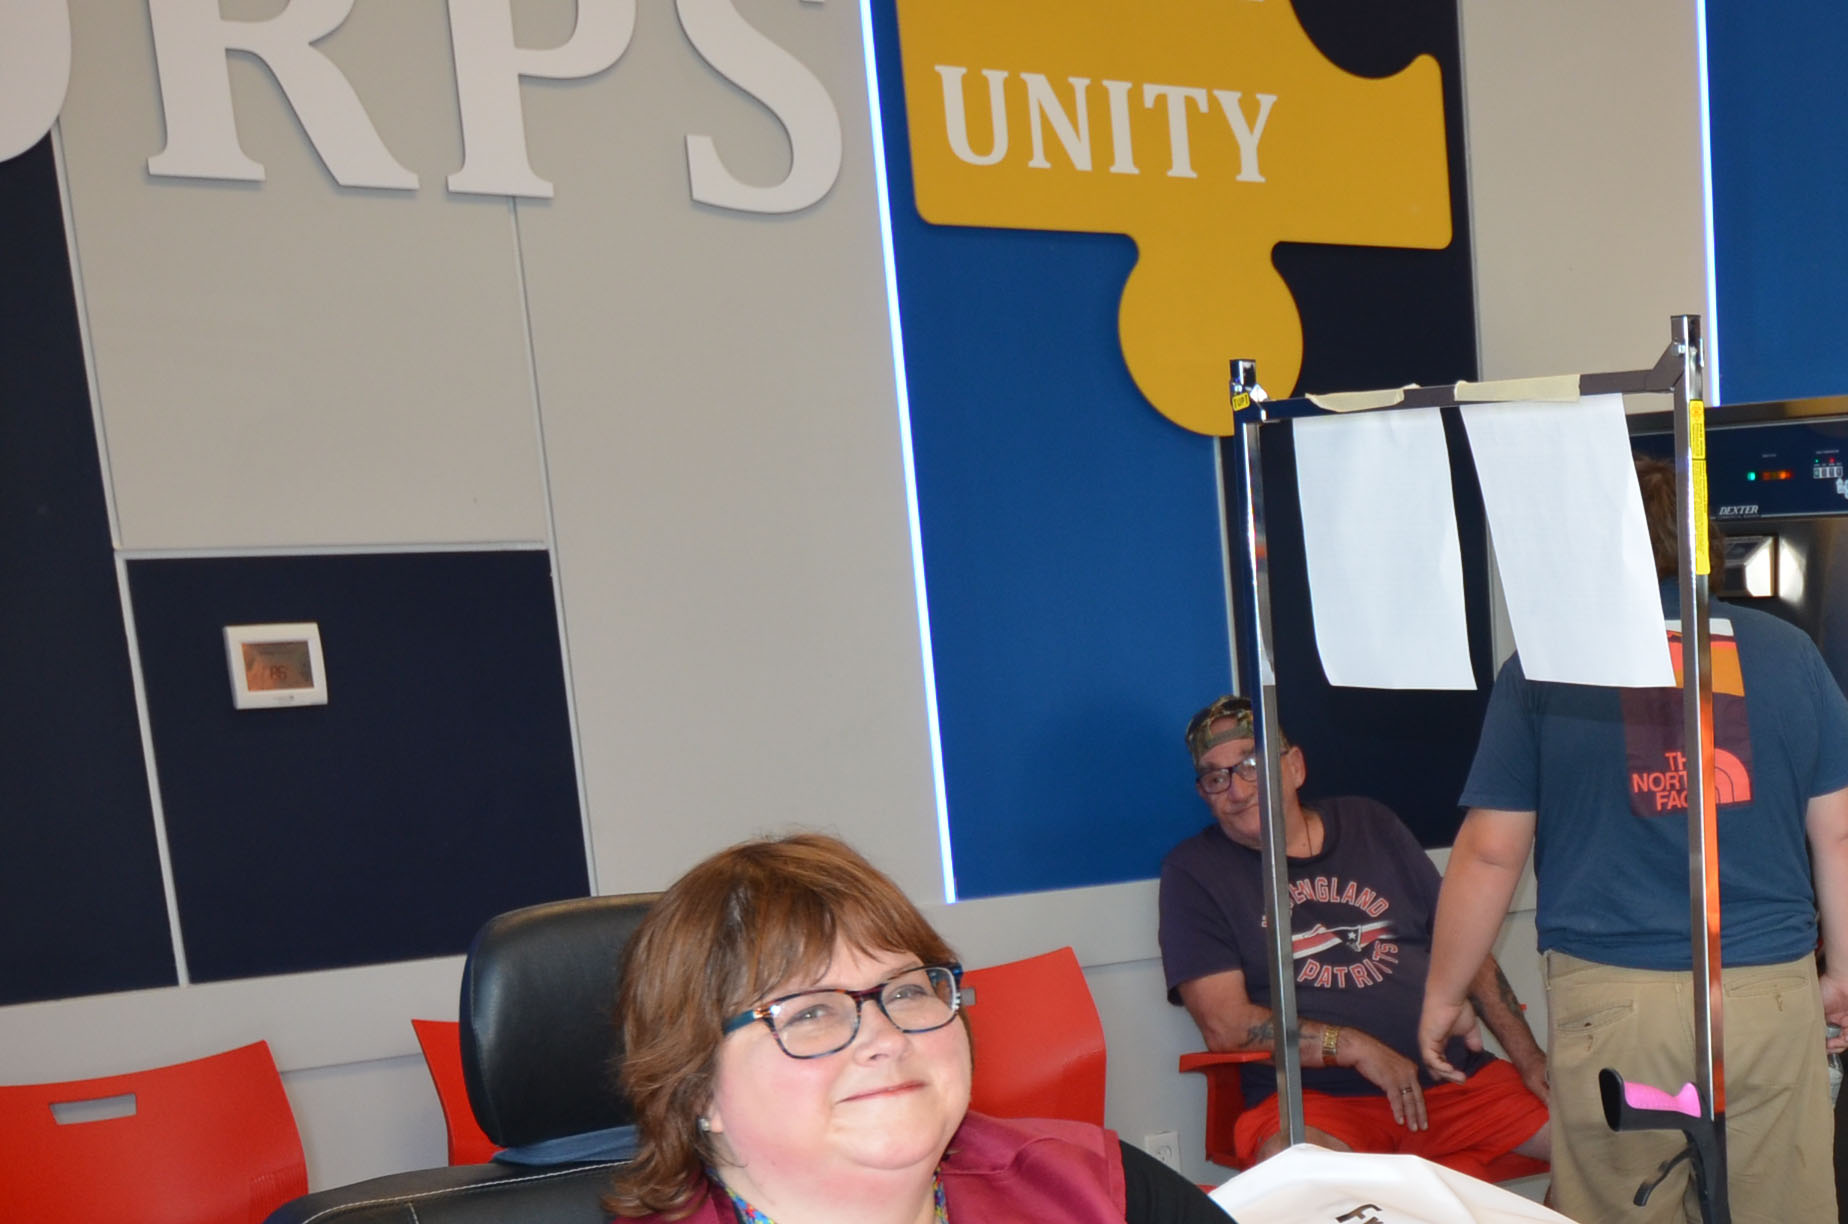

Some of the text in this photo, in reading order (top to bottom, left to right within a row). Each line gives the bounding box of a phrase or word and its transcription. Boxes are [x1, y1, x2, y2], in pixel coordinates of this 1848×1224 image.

[934, 65, 1278, 184] UNITY
[1718, 505, 1760, 515] DEXTER
[1665, 752, 1688, 771] TH
[1632, 771, 1688, 793] NORT
[1656, 792, 1688, 811] FAC
